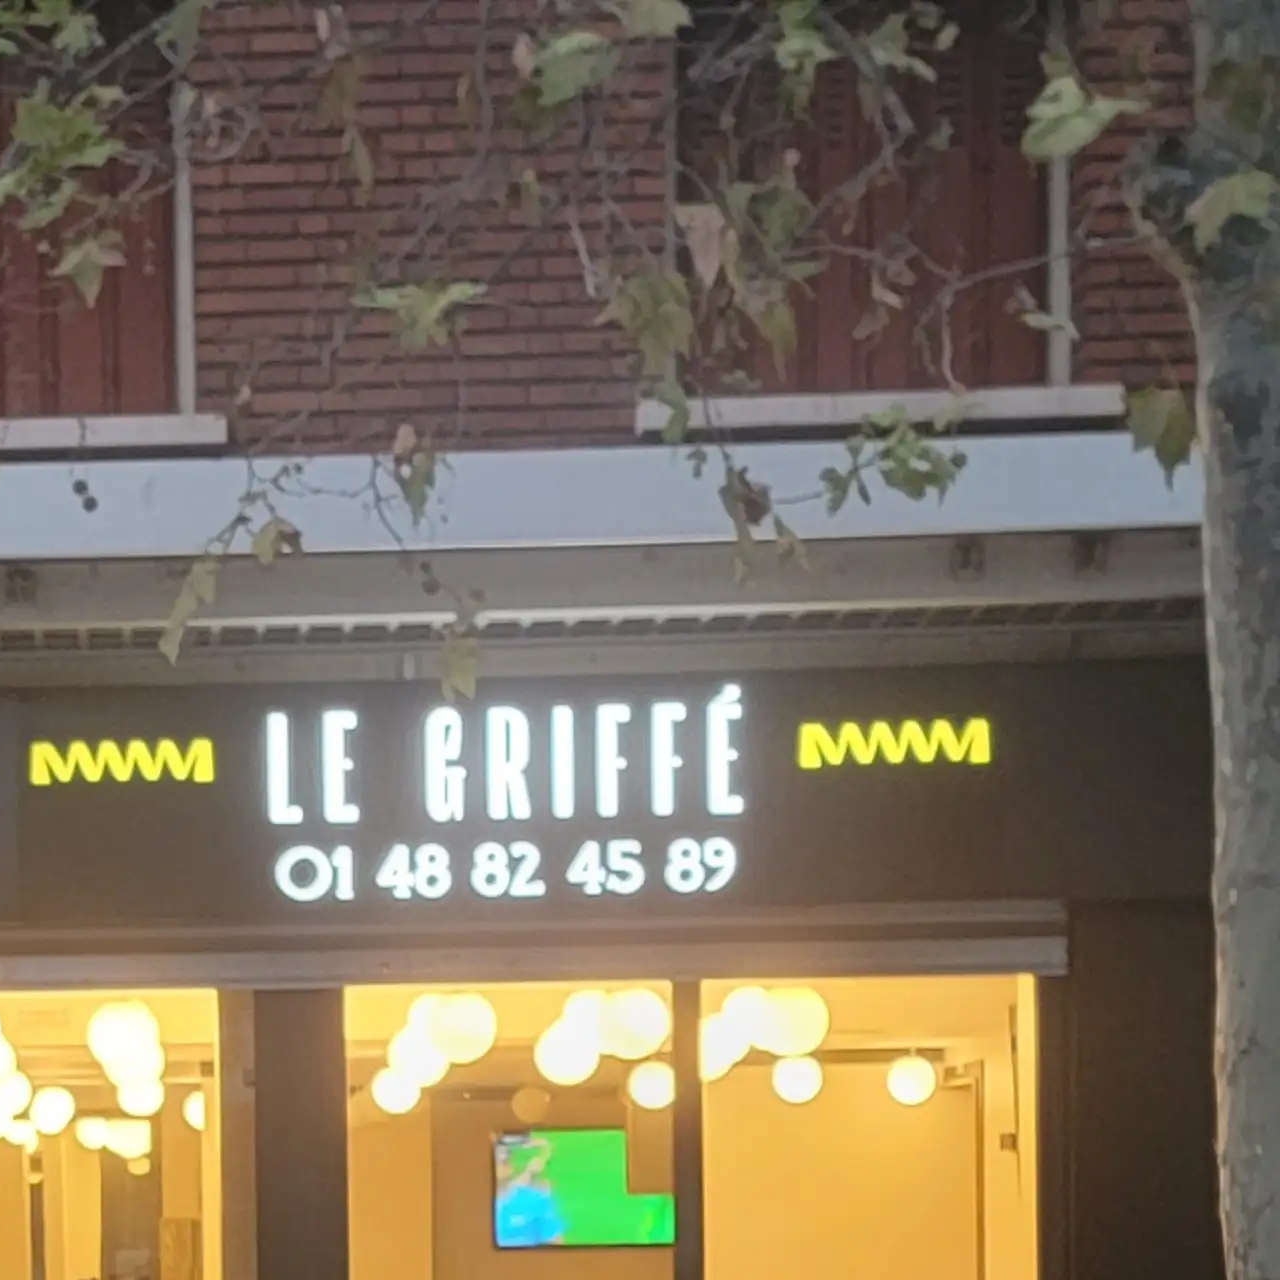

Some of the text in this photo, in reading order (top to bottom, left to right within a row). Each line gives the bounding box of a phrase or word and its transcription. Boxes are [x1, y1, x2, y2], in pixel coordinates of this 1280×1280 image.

[266, 683, 746, 824] LE GRIFFÉ
[274, 836, 738, 901] 01 48 82 45 89
